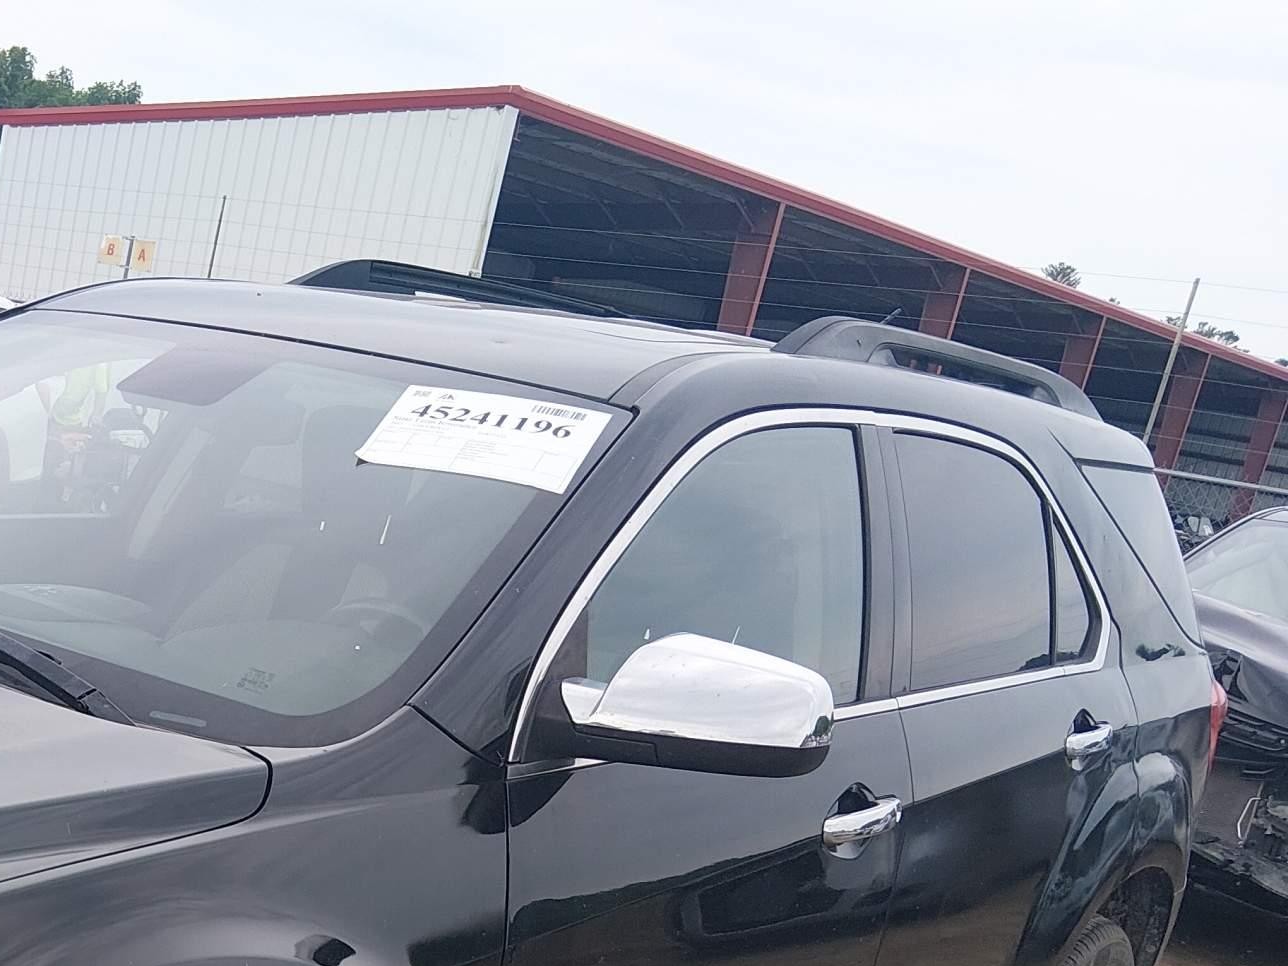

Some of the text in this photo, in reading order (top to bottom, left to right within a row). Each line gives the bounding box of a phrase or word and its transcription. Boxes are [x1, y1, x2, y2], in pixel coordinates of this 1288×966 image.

[107, 243, 115, 256] B
[137, 248, 146, 262] A
[410, 403, 576, 439] 45241196
